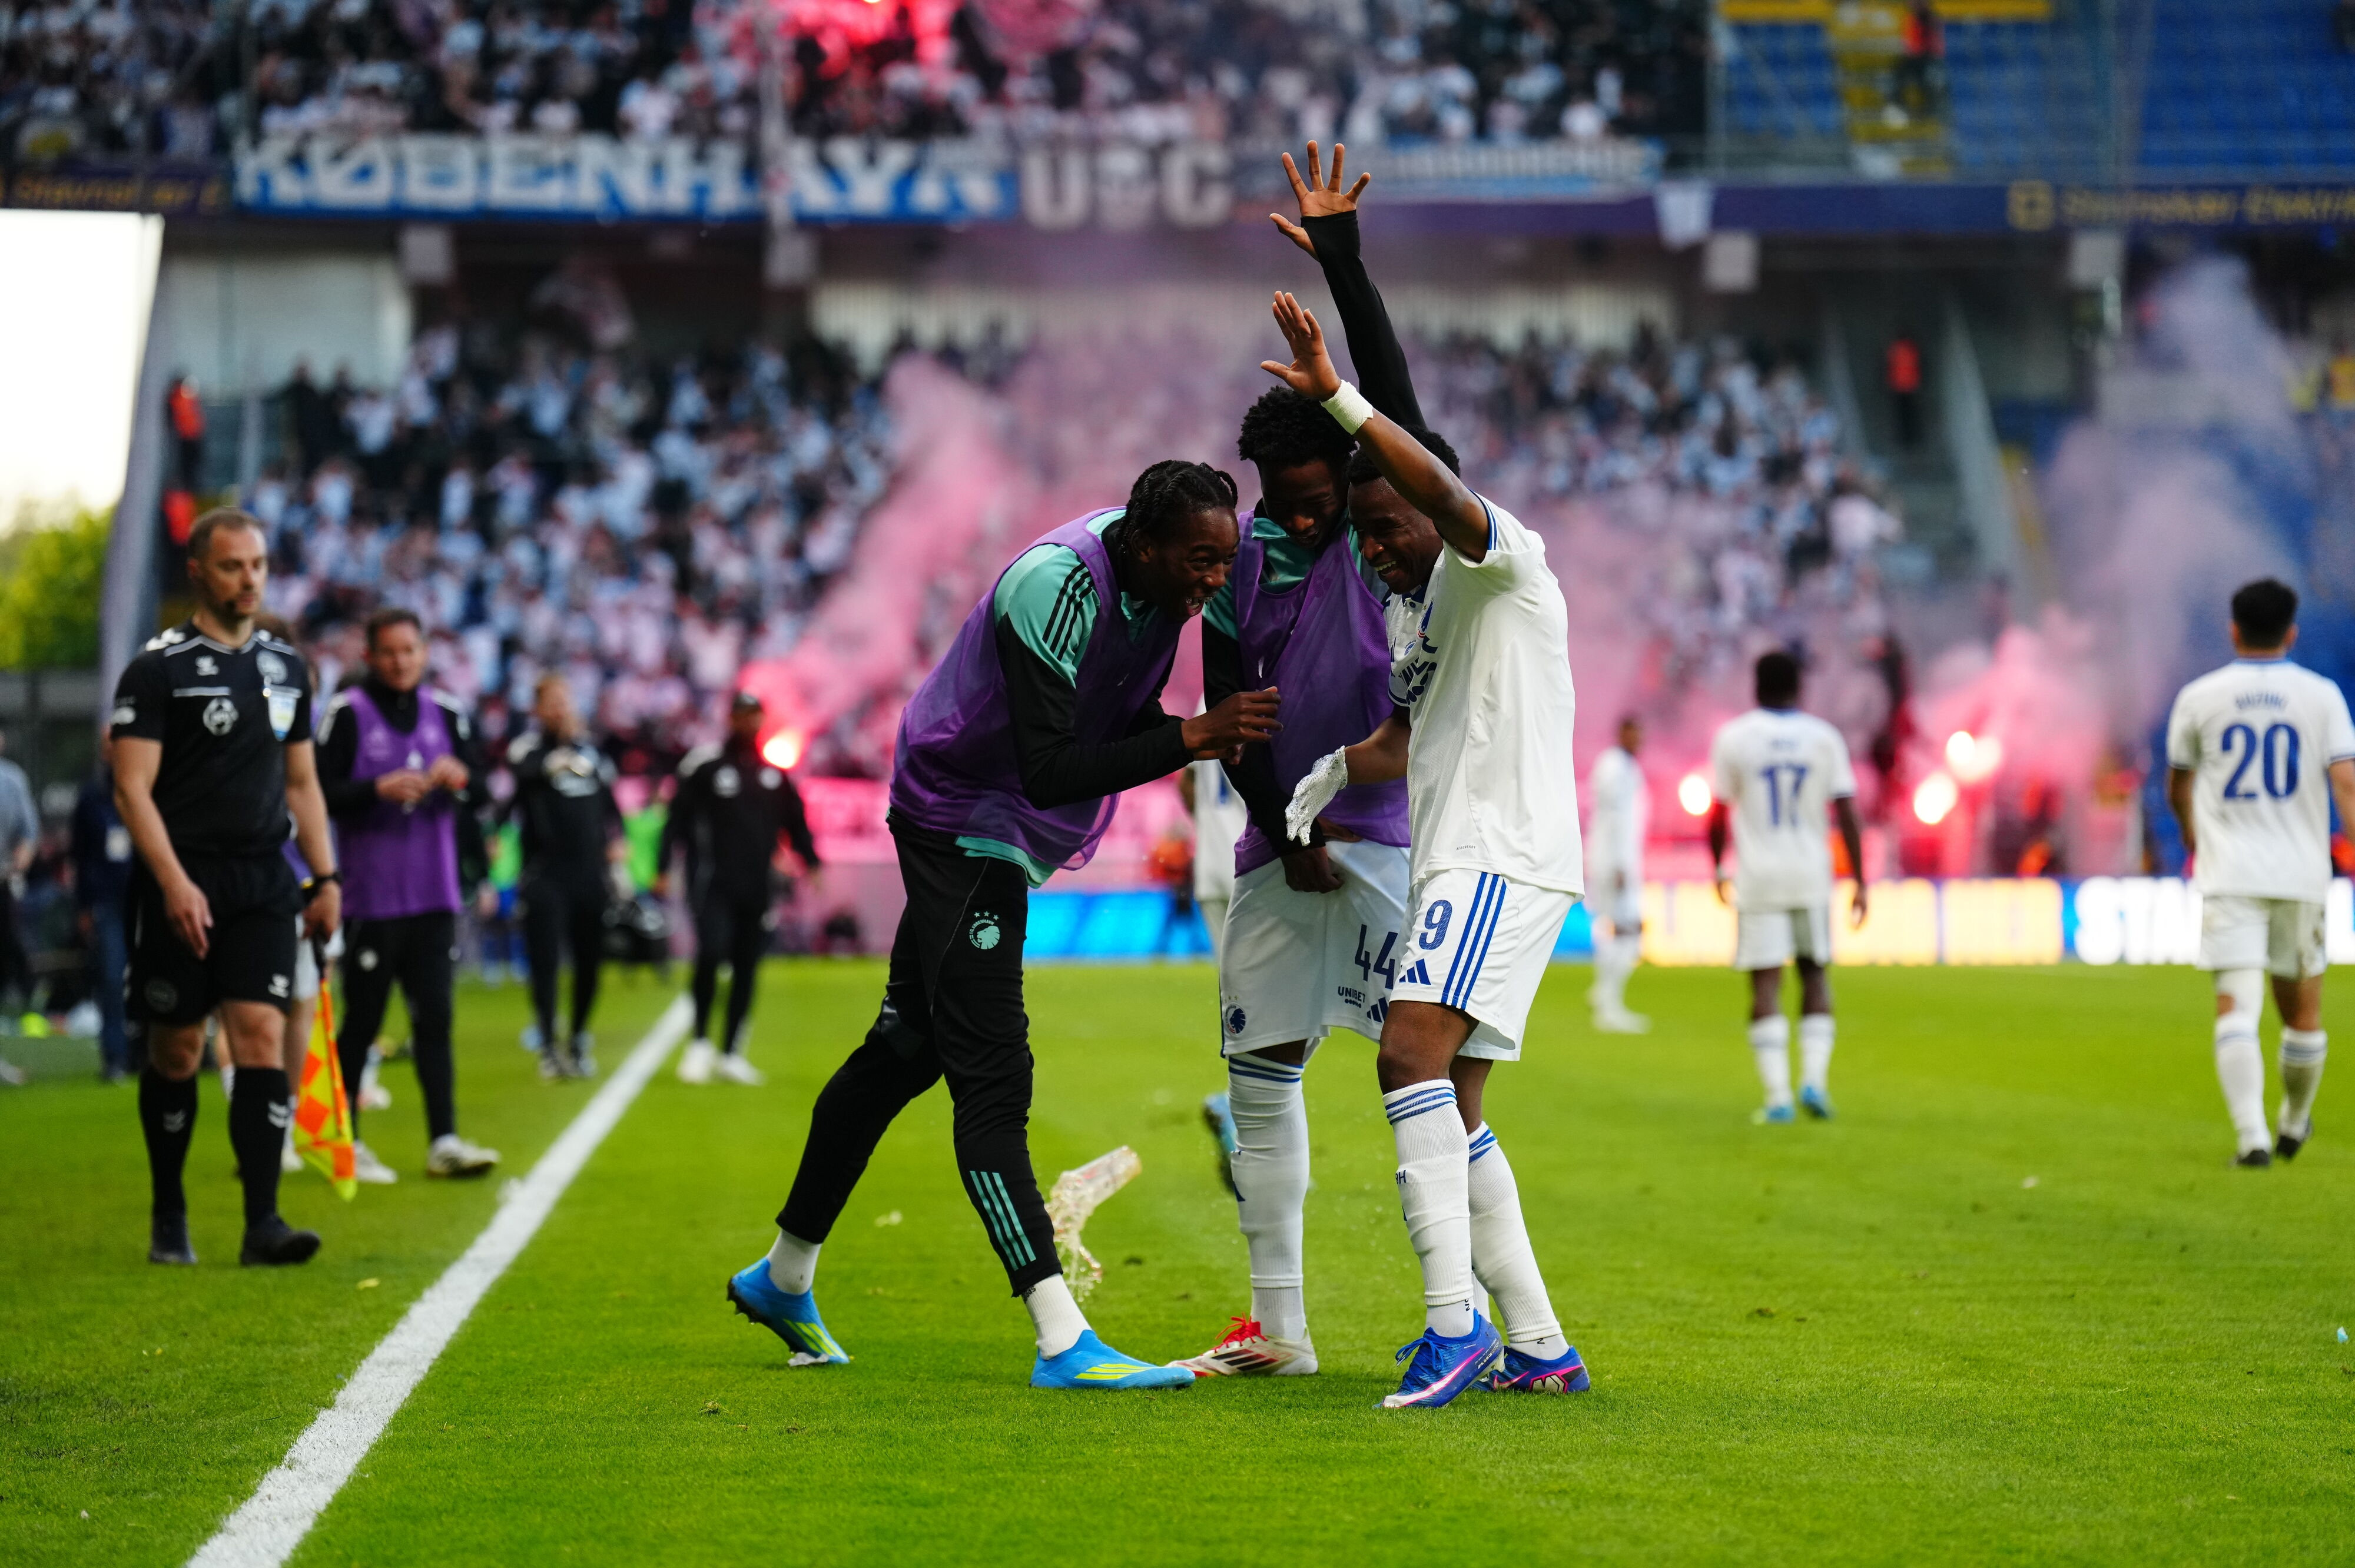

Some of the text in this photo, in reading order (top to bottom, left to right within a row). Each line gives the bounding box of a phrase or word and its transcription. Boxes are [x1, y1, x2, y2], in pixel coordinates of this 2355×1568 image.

[2222, 724, 2299, 798] 20
[1758, 763, 1809, 826] 17
[1355, 923, 1398, 990] 44
[1419, 899, 1452, 951] 9
[1338, 986, 1366, 1003] UNIBET
